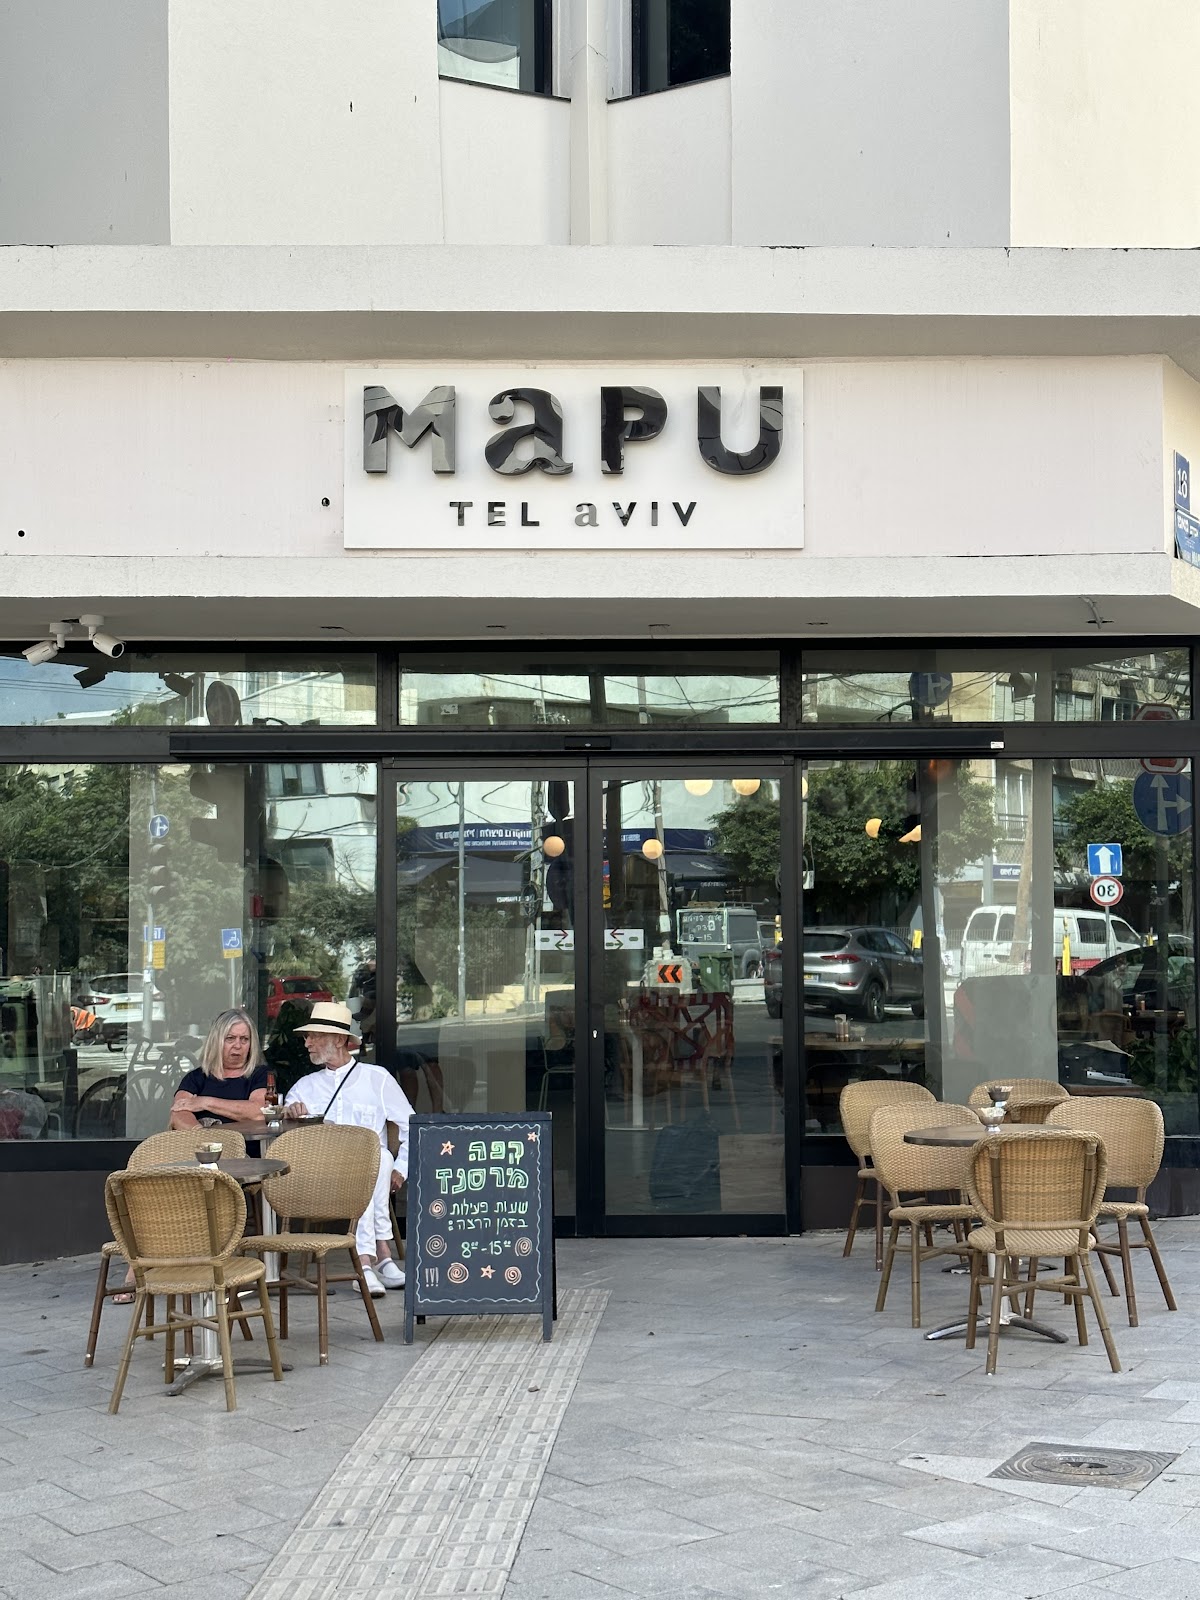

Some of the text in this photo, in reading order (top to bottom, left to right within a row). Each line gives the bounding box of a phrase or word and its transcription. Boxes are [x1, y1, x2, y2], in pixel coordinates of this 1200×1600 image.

[449, 501, 697, 527] TEL aVIV
[468, 1140, 525, 1165] קפה
[450, 1198, 529, 1216] שעות פעילות
[496, 1218, 529, 1235] בזמן
